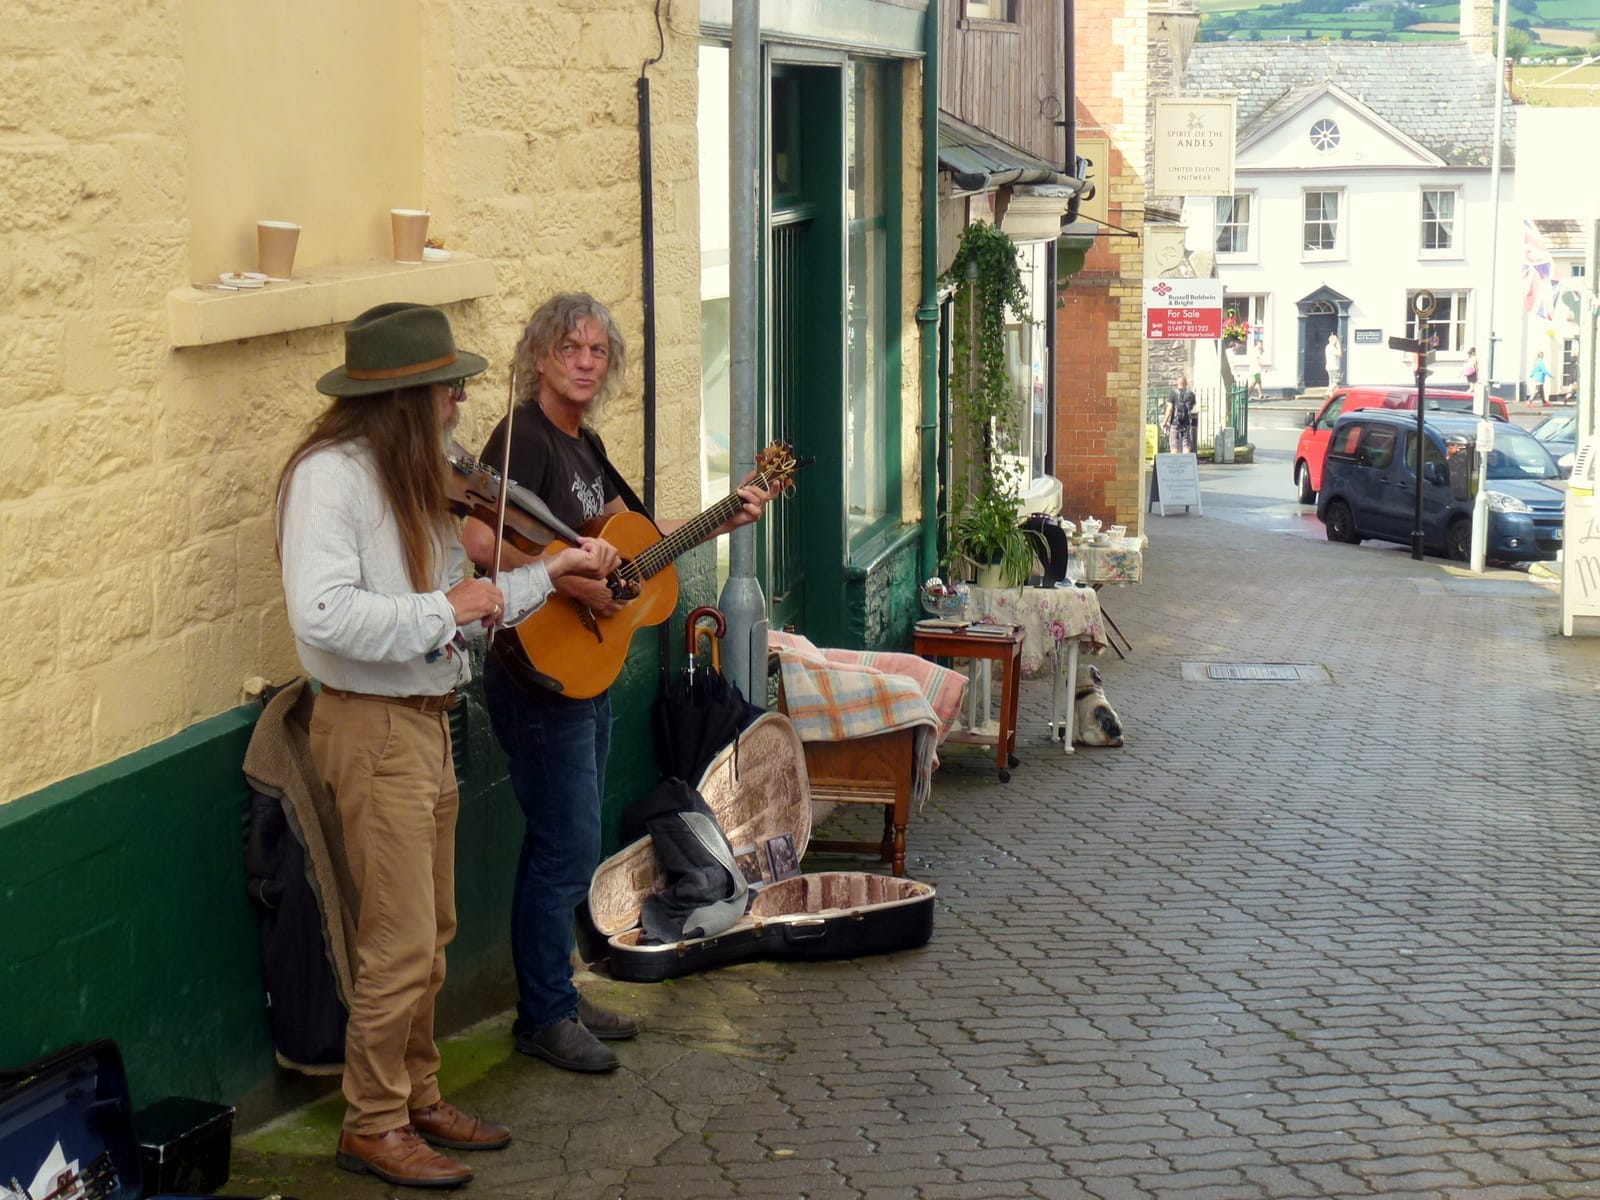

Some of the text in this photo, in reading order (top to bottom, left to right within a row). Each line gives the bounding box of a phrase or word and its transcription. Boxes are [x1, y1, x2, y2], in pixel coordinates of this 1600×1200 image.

[1177, 139, 1214, 147] ANDES
[1167, 309, 1200, 318] For Sale
